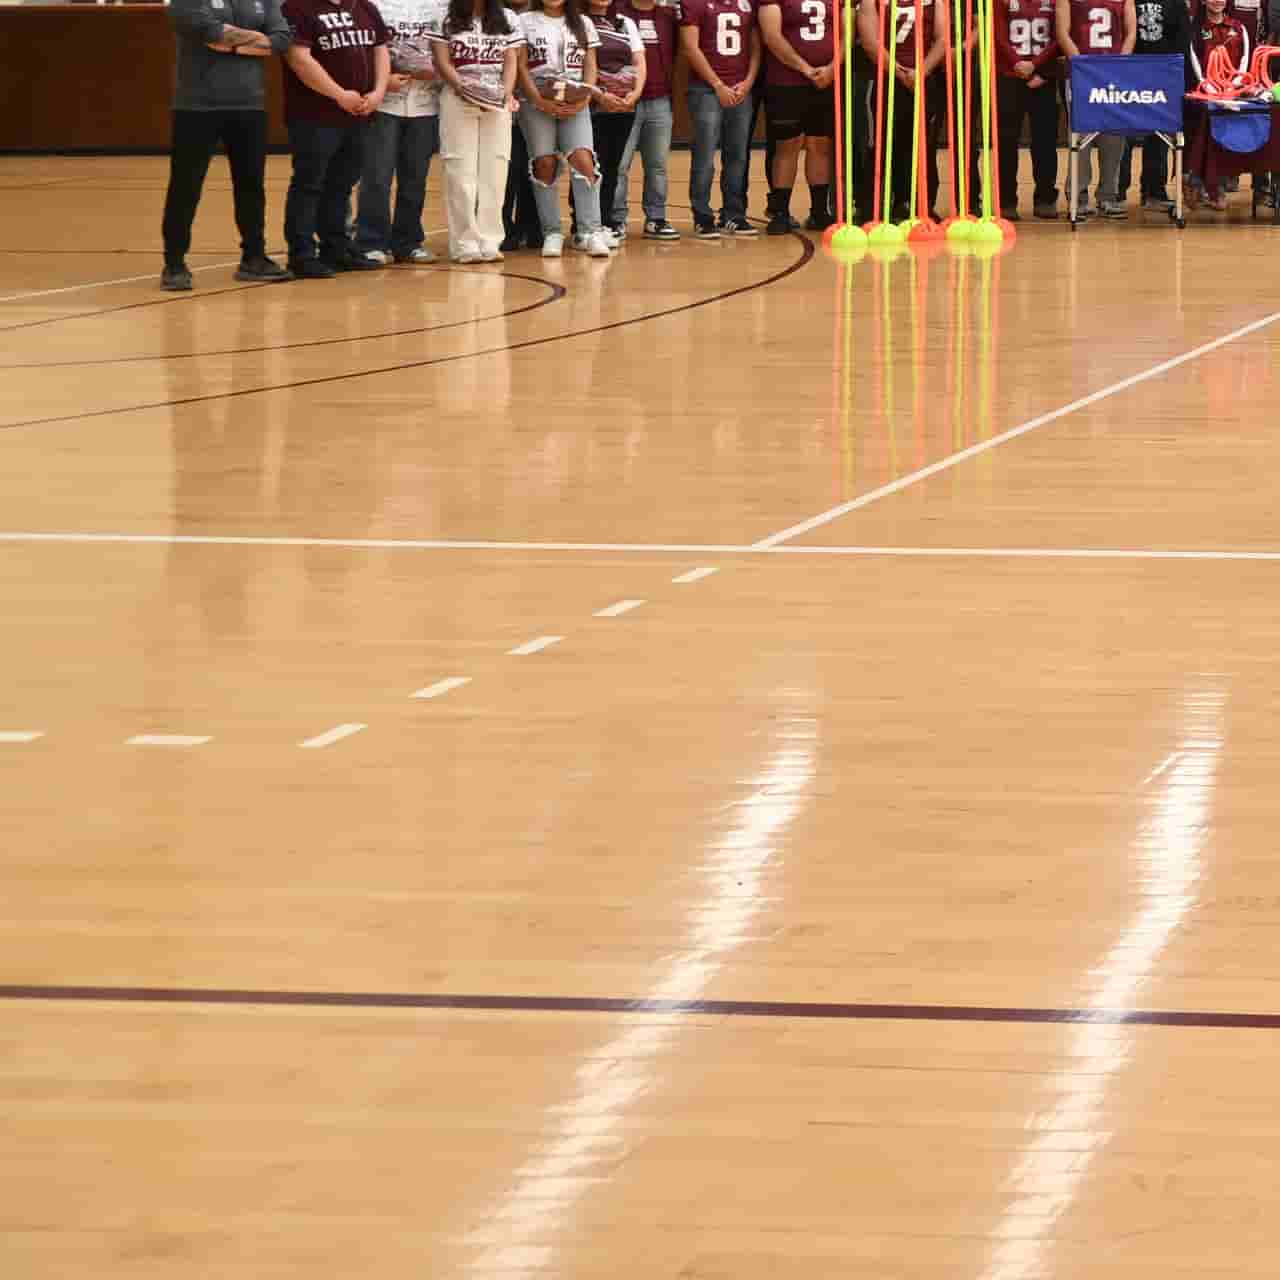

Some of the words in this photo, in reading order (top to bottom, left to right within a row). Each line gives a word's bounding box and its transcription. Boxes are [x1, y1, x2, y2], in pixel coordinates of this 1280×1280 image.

[318, 12, 353, 28] TEC
[717, 12, 741, 55] 6
[800, 0, 826, 40] 3
[1009, 18, 1050, 55] 99
[1088, 7, 1113, 48] 2
